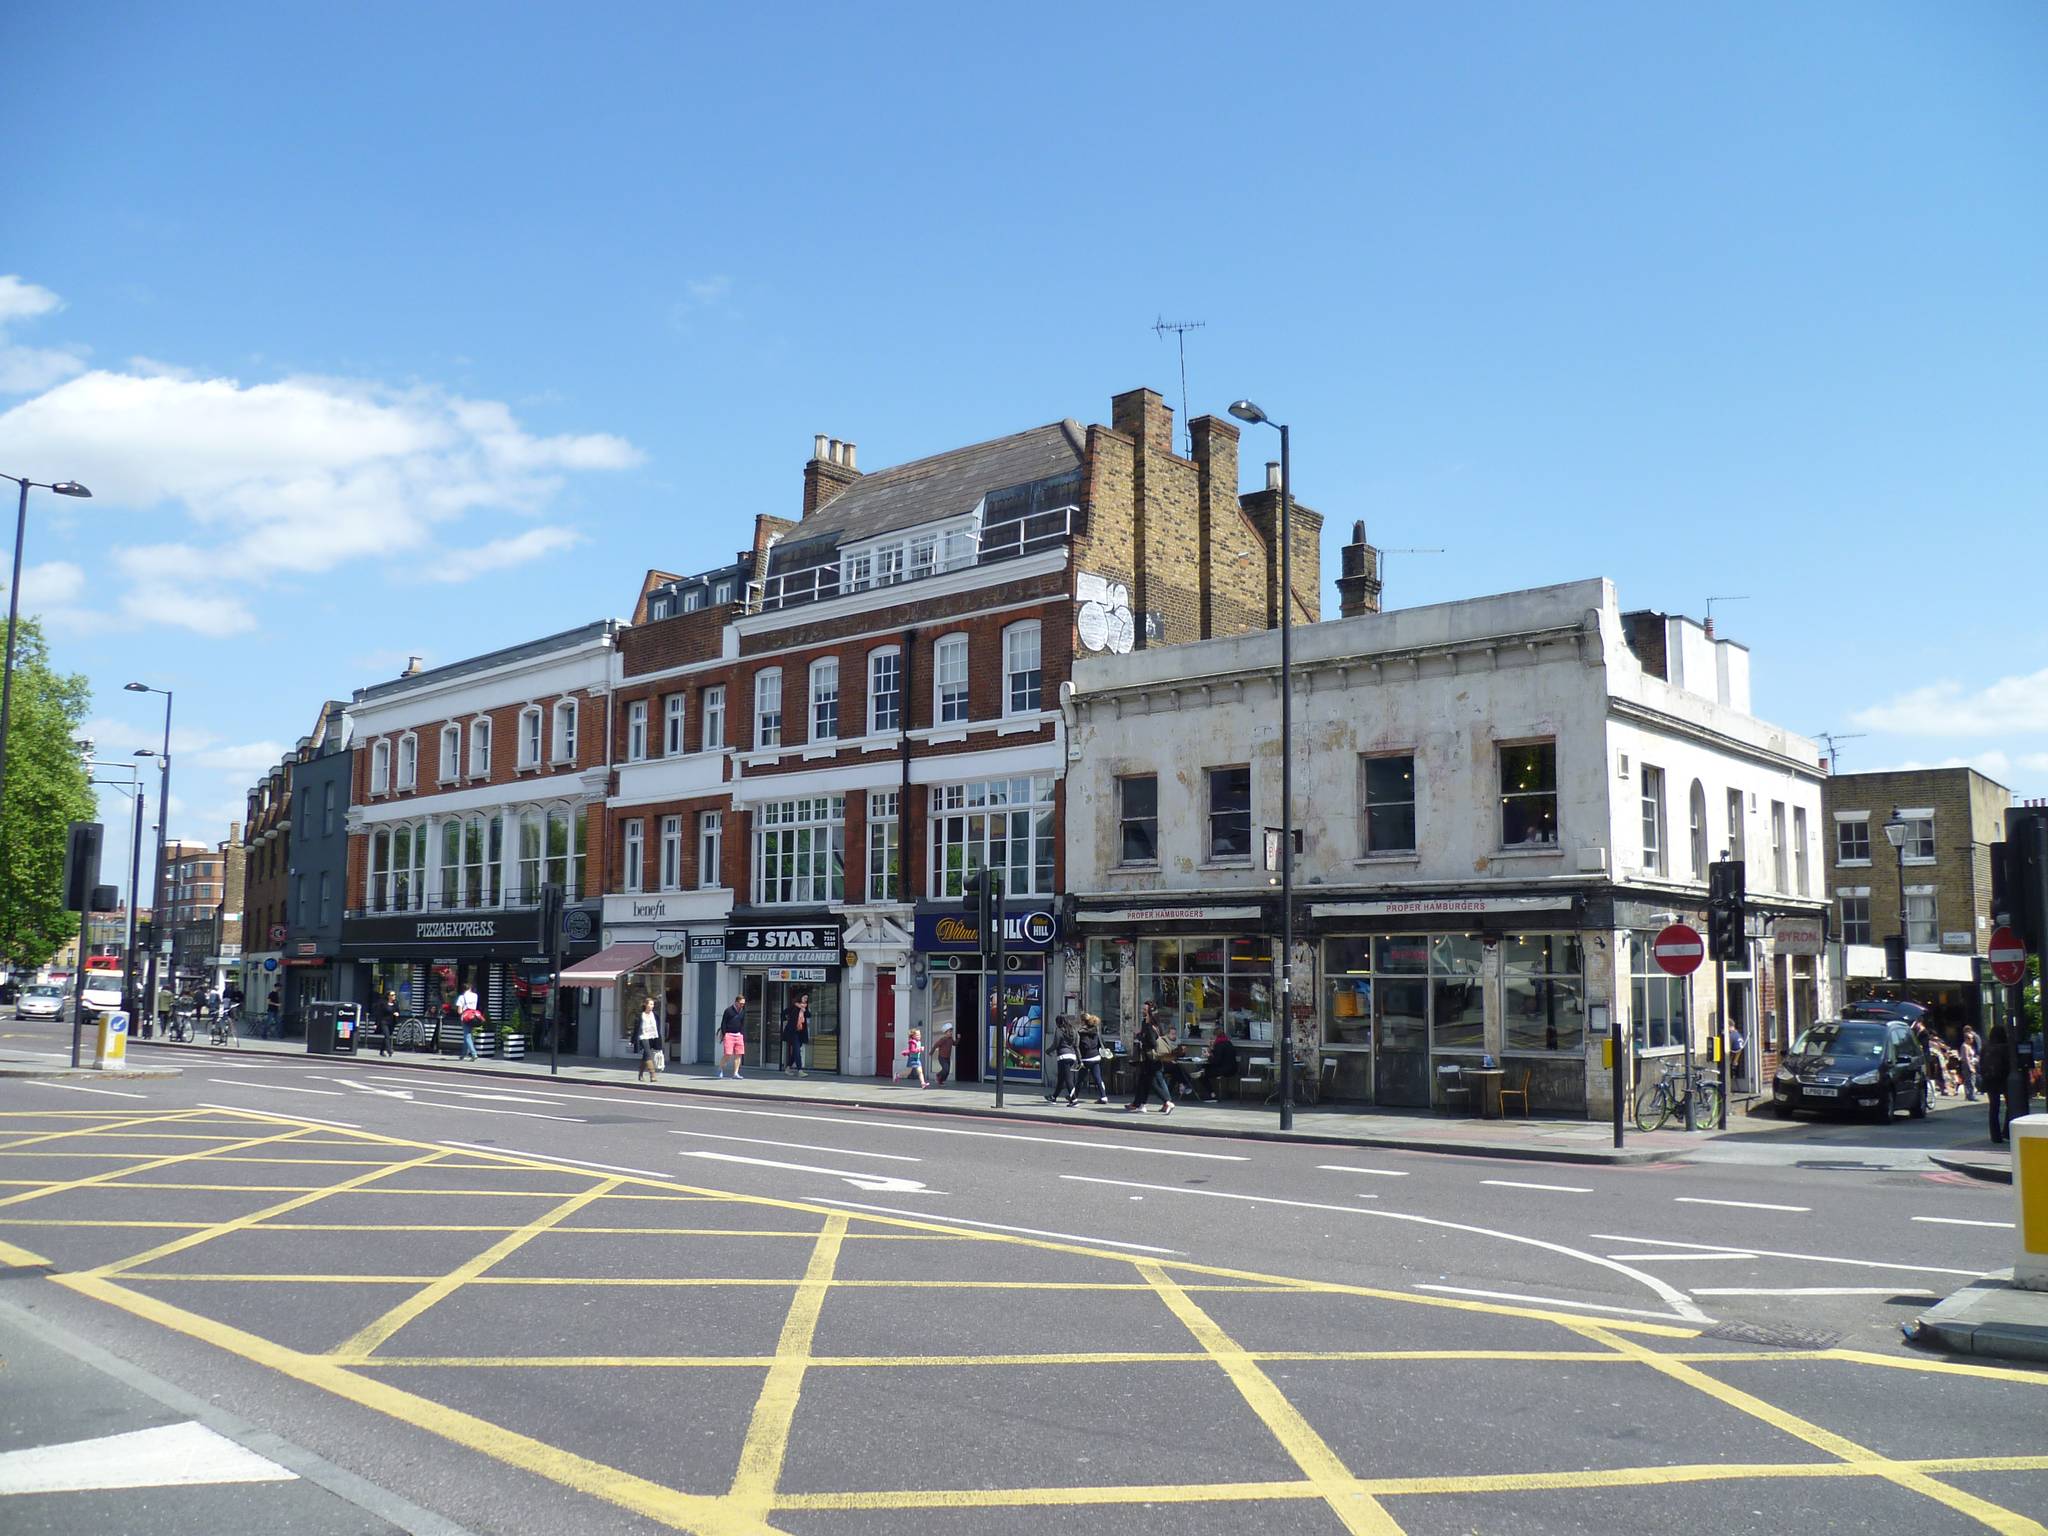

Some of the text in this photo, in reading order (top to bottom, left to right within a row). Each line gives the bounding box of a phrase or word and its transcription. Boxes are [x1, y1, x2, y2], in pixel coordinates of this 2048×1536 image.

[633, 899, 666, 920] benefit
[1386, 902, 1486, 912] PROPER HAMBURGERS
[1127, 910, 1204, 919] PROPER HAMBURGERS
[416, 920, 494, 938] PIZZAEXPRESS
[1033, 925, 1049, 936] HILL
[701, 938, 722, 946] STAR
[746, 930, 816, 948] 5 STAR
[1777, 930, 1819, 943] BYRON
[656, 941, 682, 952] benefit
[728, 952, 836, 961] 2 HR DELUXE DRY CLEANERS
[798, 970, 812, 980] ALL
